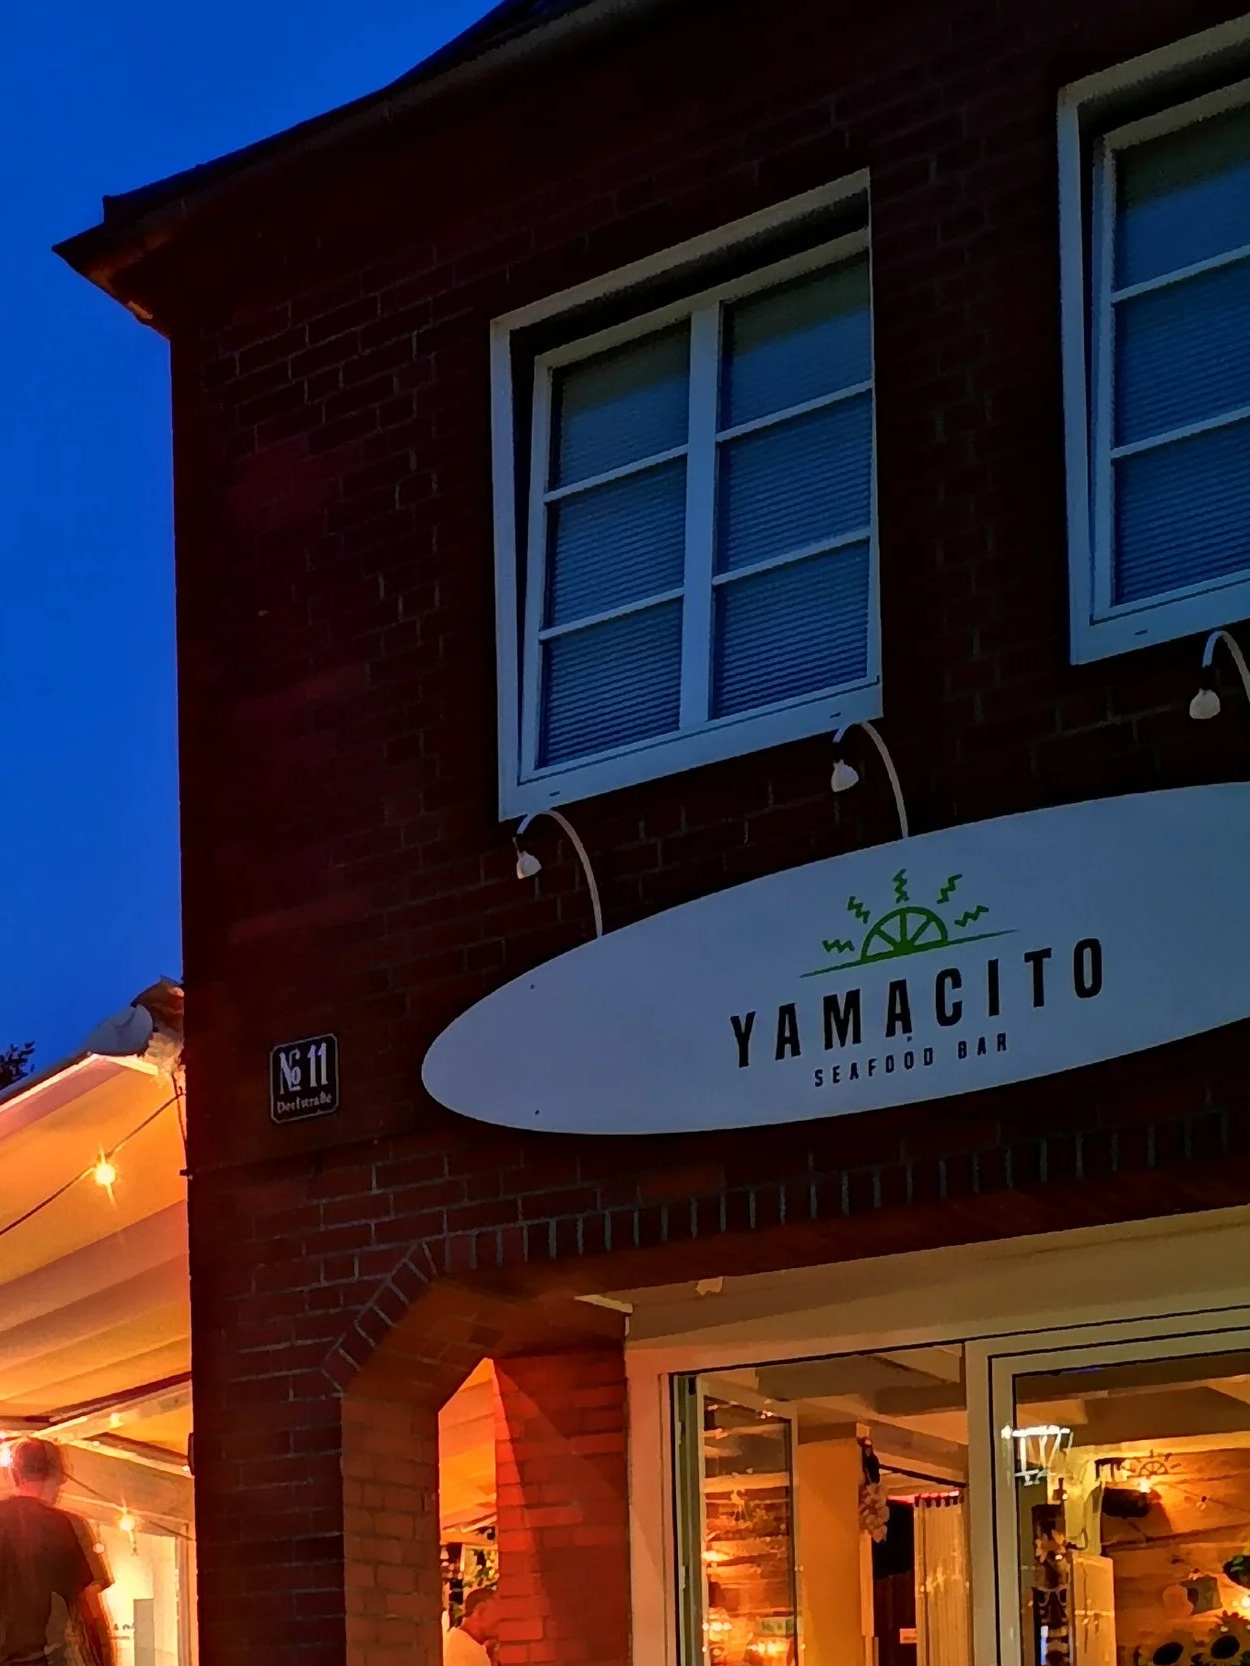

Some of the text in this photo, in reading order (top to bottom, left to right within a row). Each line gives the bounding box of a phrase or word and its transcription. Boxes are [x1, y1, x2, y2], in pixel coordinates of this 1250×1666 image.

[729, 937, 1103, 1068] YAMACITO
[307, 1042, 328, 1087] 11
[813, 1032, 1008, 1088] SEAFOOD BAR
